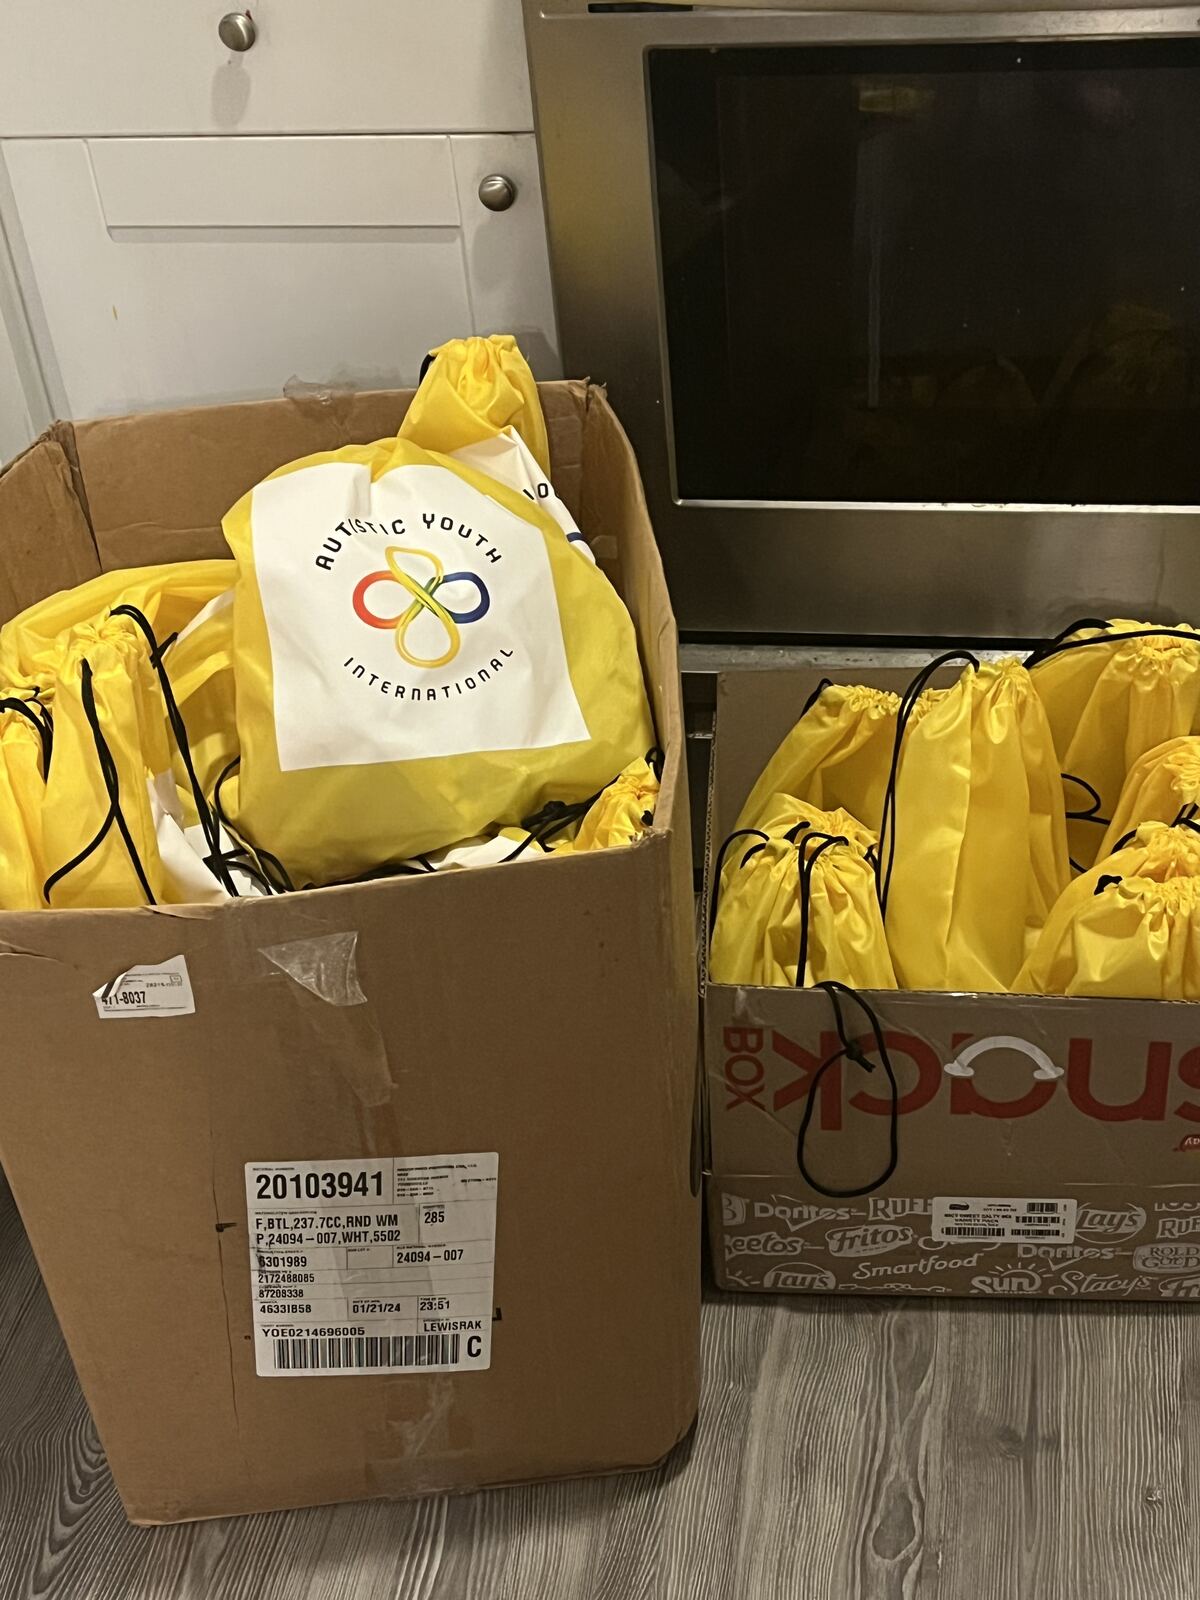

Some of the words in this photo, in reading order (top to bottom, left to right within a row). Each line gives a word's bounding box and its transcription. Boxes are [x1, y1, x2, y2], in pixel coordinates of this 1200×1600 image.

[315, 518, 406, 570] AUTISTIC
[422, 513, 502, 563] YOUTH
[343, 648, 514, 701] INTERNATIONAL
[723, 1026, 766, 1111] BOX
[772, 1030, 1200, 1132] nack
[256, 1170, 384, 1199] 20103941
[376, 1214, 399, 1228] WM
[424, 1211, 445, 1224] 285
[753, 1201, 851, 1221] Doritos
[1077, 1206, 1142, 1235] Lay's
[726, 1234, 801, 1255] eetos
[827, 1225, 913, 1254] Fritos
[258, 1255, 308, 1268] 6301989
[1018, 1244, 1115, 1260] Doritos
[852, 1253, 984, 1280] Smartfood
[258, 1273, 315, 1284] 2172488085
[258, 1288, 304, 1299] 87208338
[352, 1302, 401, 1314] 01/21/24
[419, 1300, 451, 1312] 23:51
[423, 1320, 482, 1333] LEWISRAK
[467, 1335, 482, 1358] C
